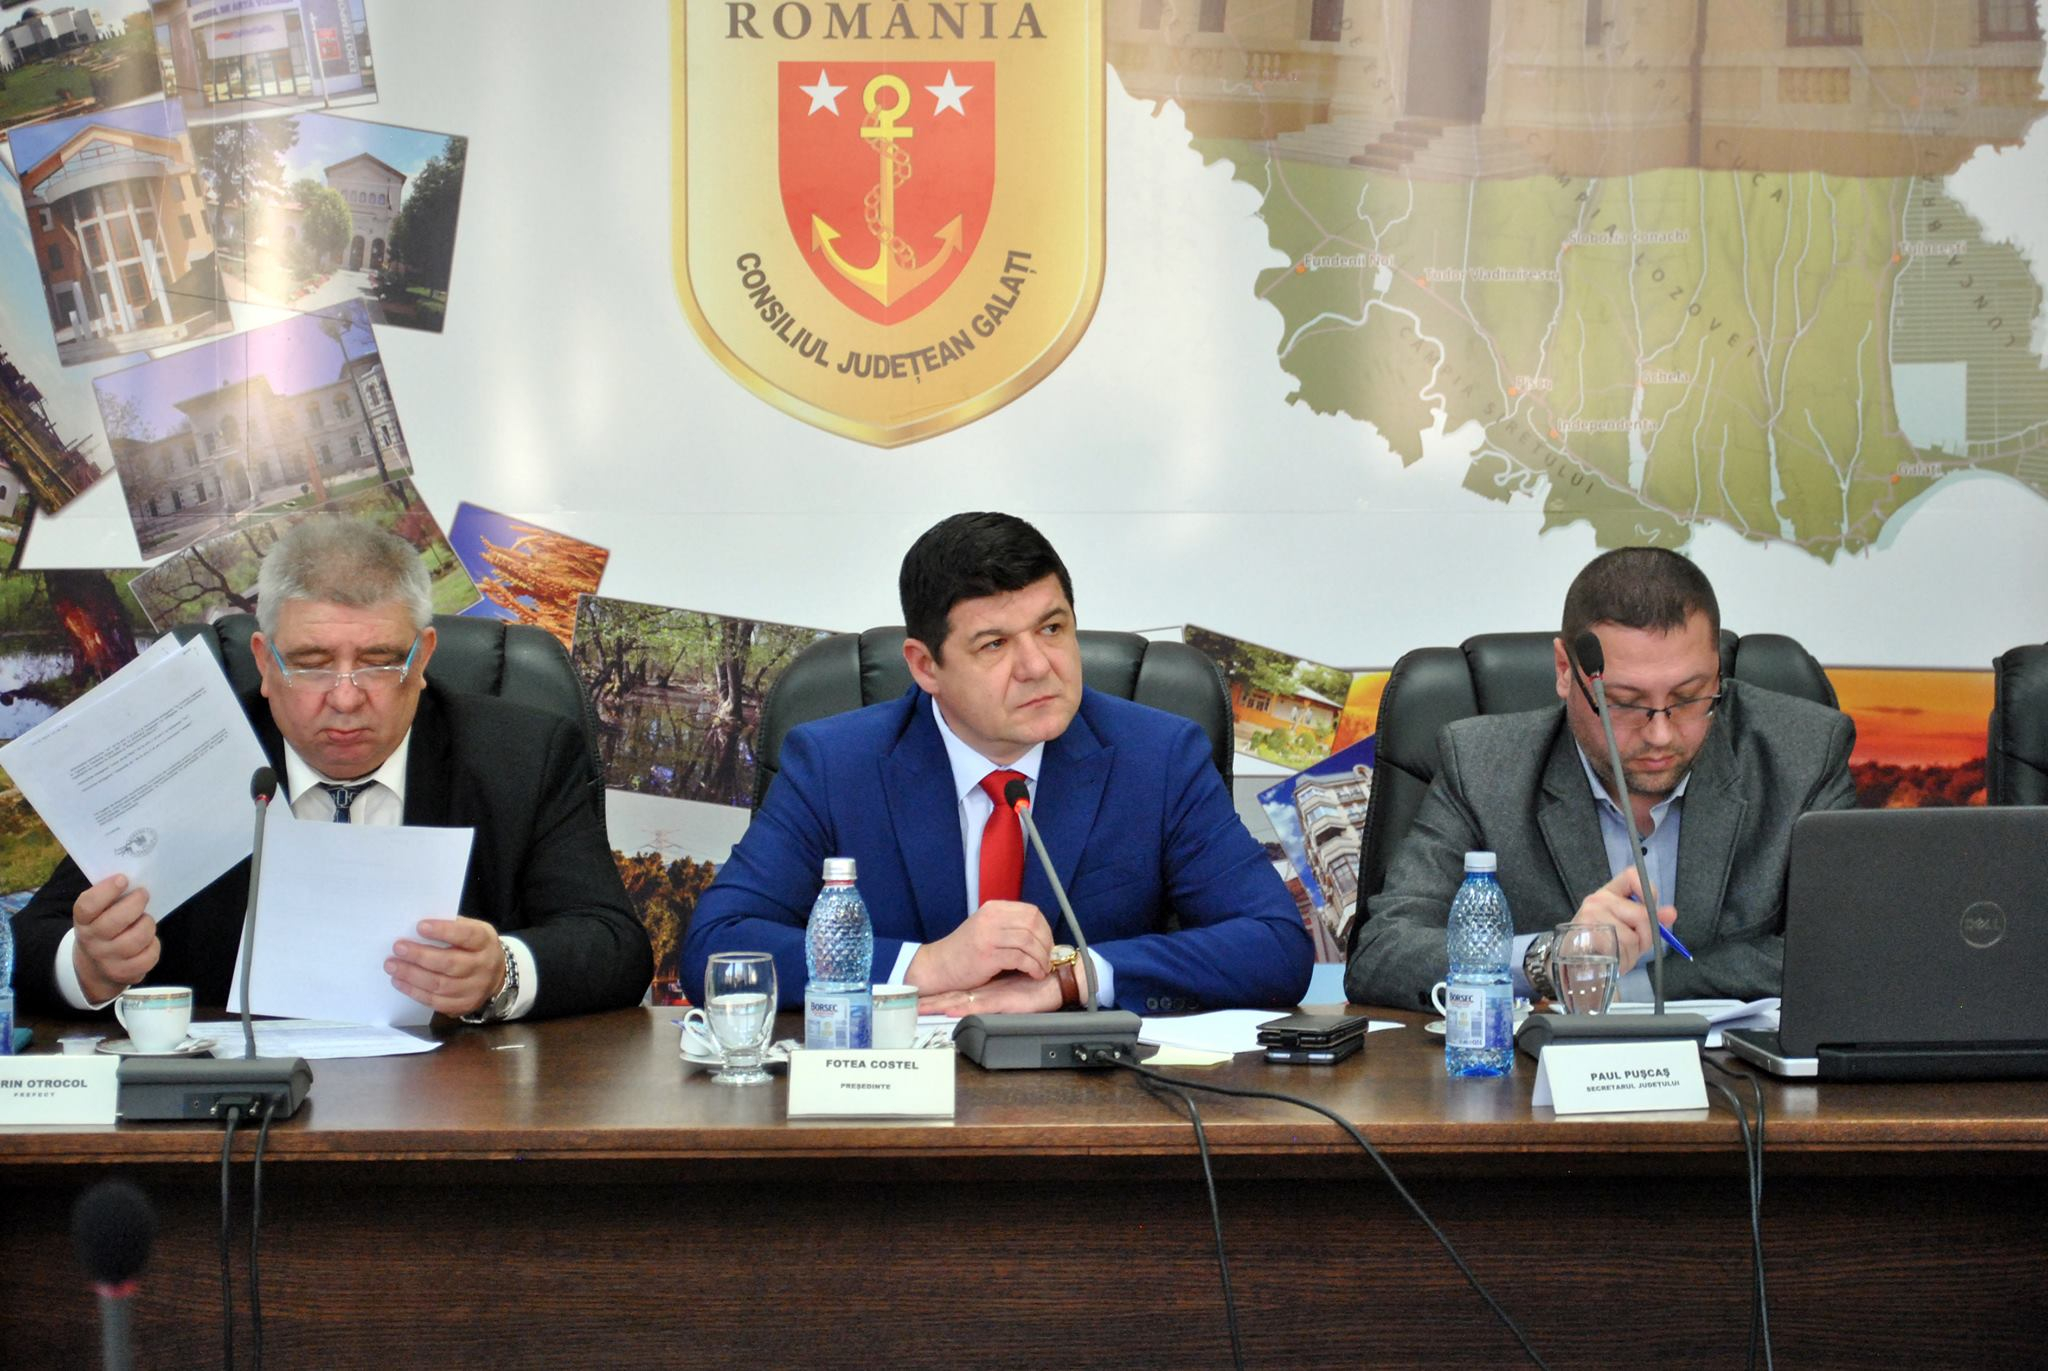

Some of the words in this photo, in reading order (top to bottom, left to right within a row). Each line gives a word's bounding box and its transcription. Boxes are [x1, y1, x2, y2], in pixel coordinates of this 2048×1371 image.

[725, 0, 1048, 40] ROMÂNIA
[736, 251, 830, 368] CONSILIUL
[825, 1059, 866, 1068] FOTEA
[870, 1059, 919, 1070] COSTEL
[1590, 1070, 1622, 1082] PAUL
[26, 1079, 87, 1088] OTROCOL
[1586, 1083, 1636, 1093] SECRETARUL
